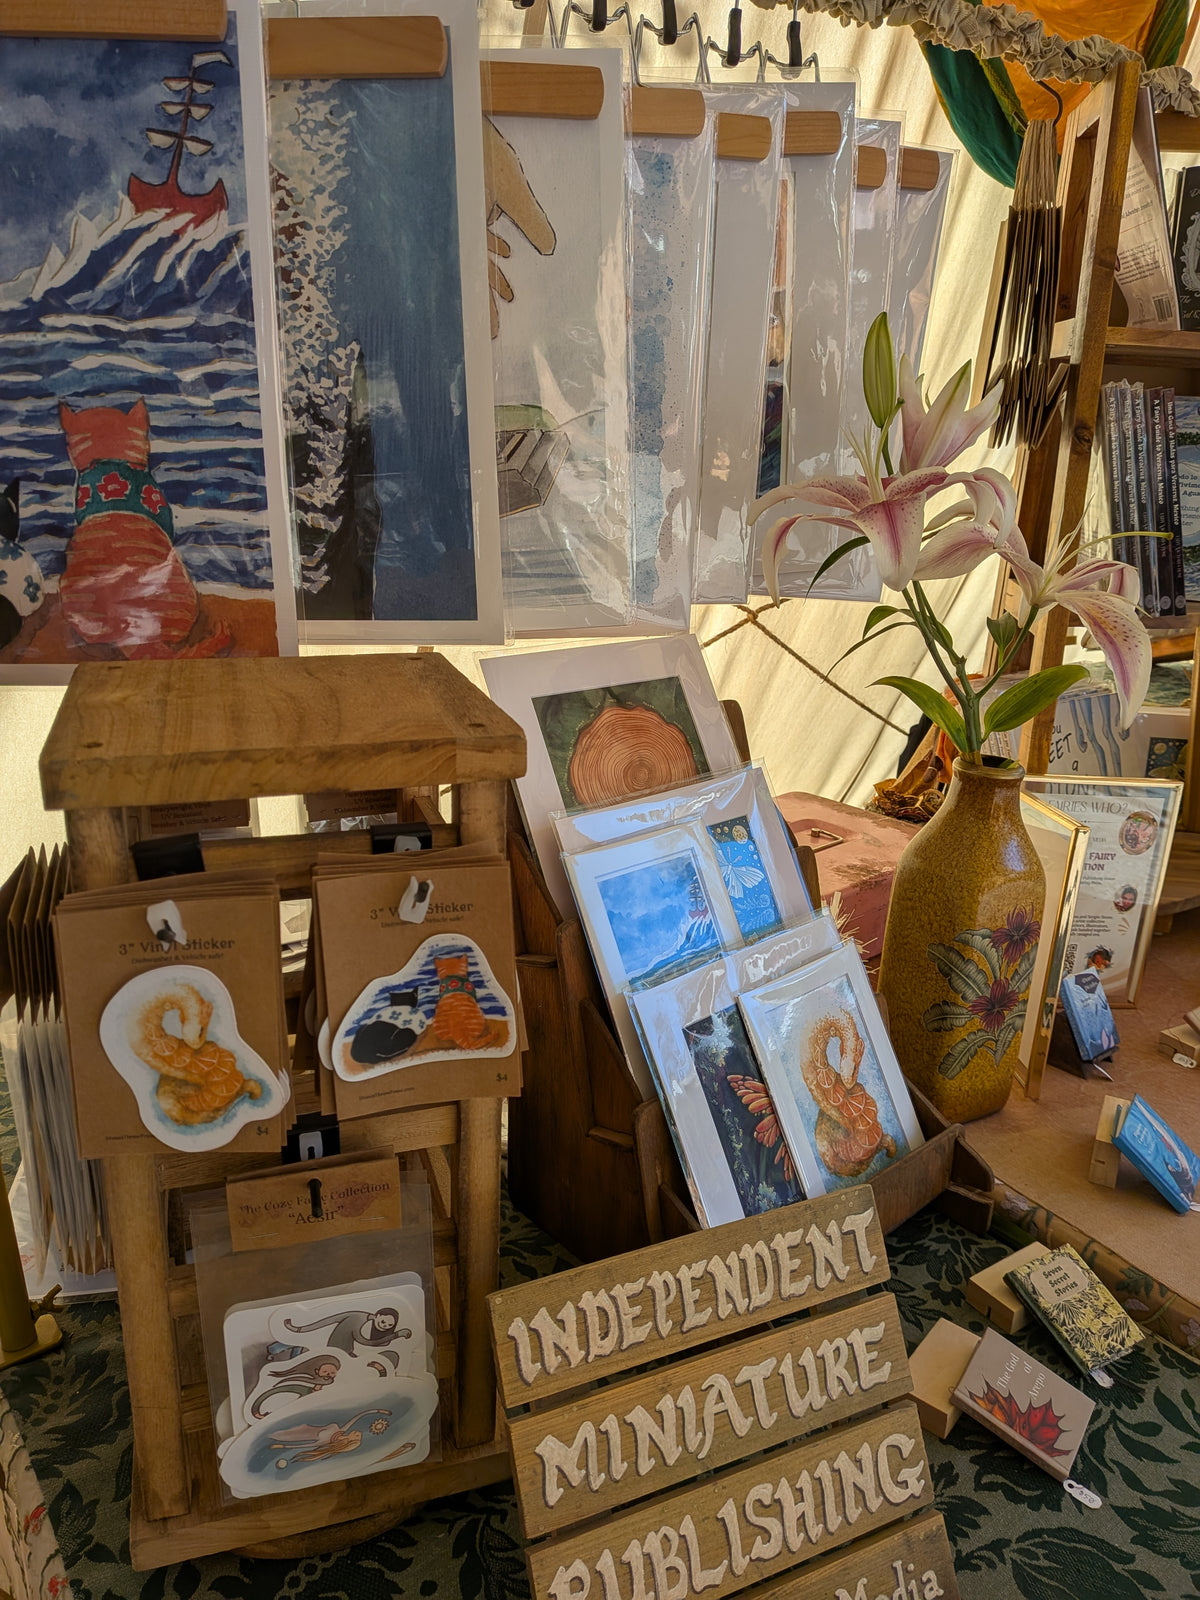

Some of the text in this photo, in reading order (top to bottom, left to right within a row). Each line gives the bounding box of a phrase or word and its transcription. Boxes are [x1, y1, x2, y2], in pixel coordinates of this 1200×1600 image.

[1072, 760, 1079, 771] a
[1091, 802, 1128, 815] WHO?
[1089, 852, 1116, 860] FAIRY
[426, 902, 474, 914] Sticker
[140, 940, 177, 953] Vinyl
[182, 938, 235, 950] Sticker
[256, 1126, 269, 1136] $4
[240, 1203, 260, 1214] The
[264, 1199, 292, 1211] Cozy
[330, 1182, 390, 1200] Collection
[1043, 1265, 1063, 1279] Seven
[1049, 1272, 1070, 1288] Secret
[507, 1206, 875, 1386] INDEPENDENT
[1055, 1281, 1078, 1296] Stories
[996, 1352, 1020, 1388] The God
[1024, 1361, 1032, 1374] of
[1028, 1372, 1045, 1400] Arepo
[534, 1321, 892, 1508] MINIATURE
[547, 1432, 925, 1600] PUBLISHING
[835, 1560, 944, 1600] dia
